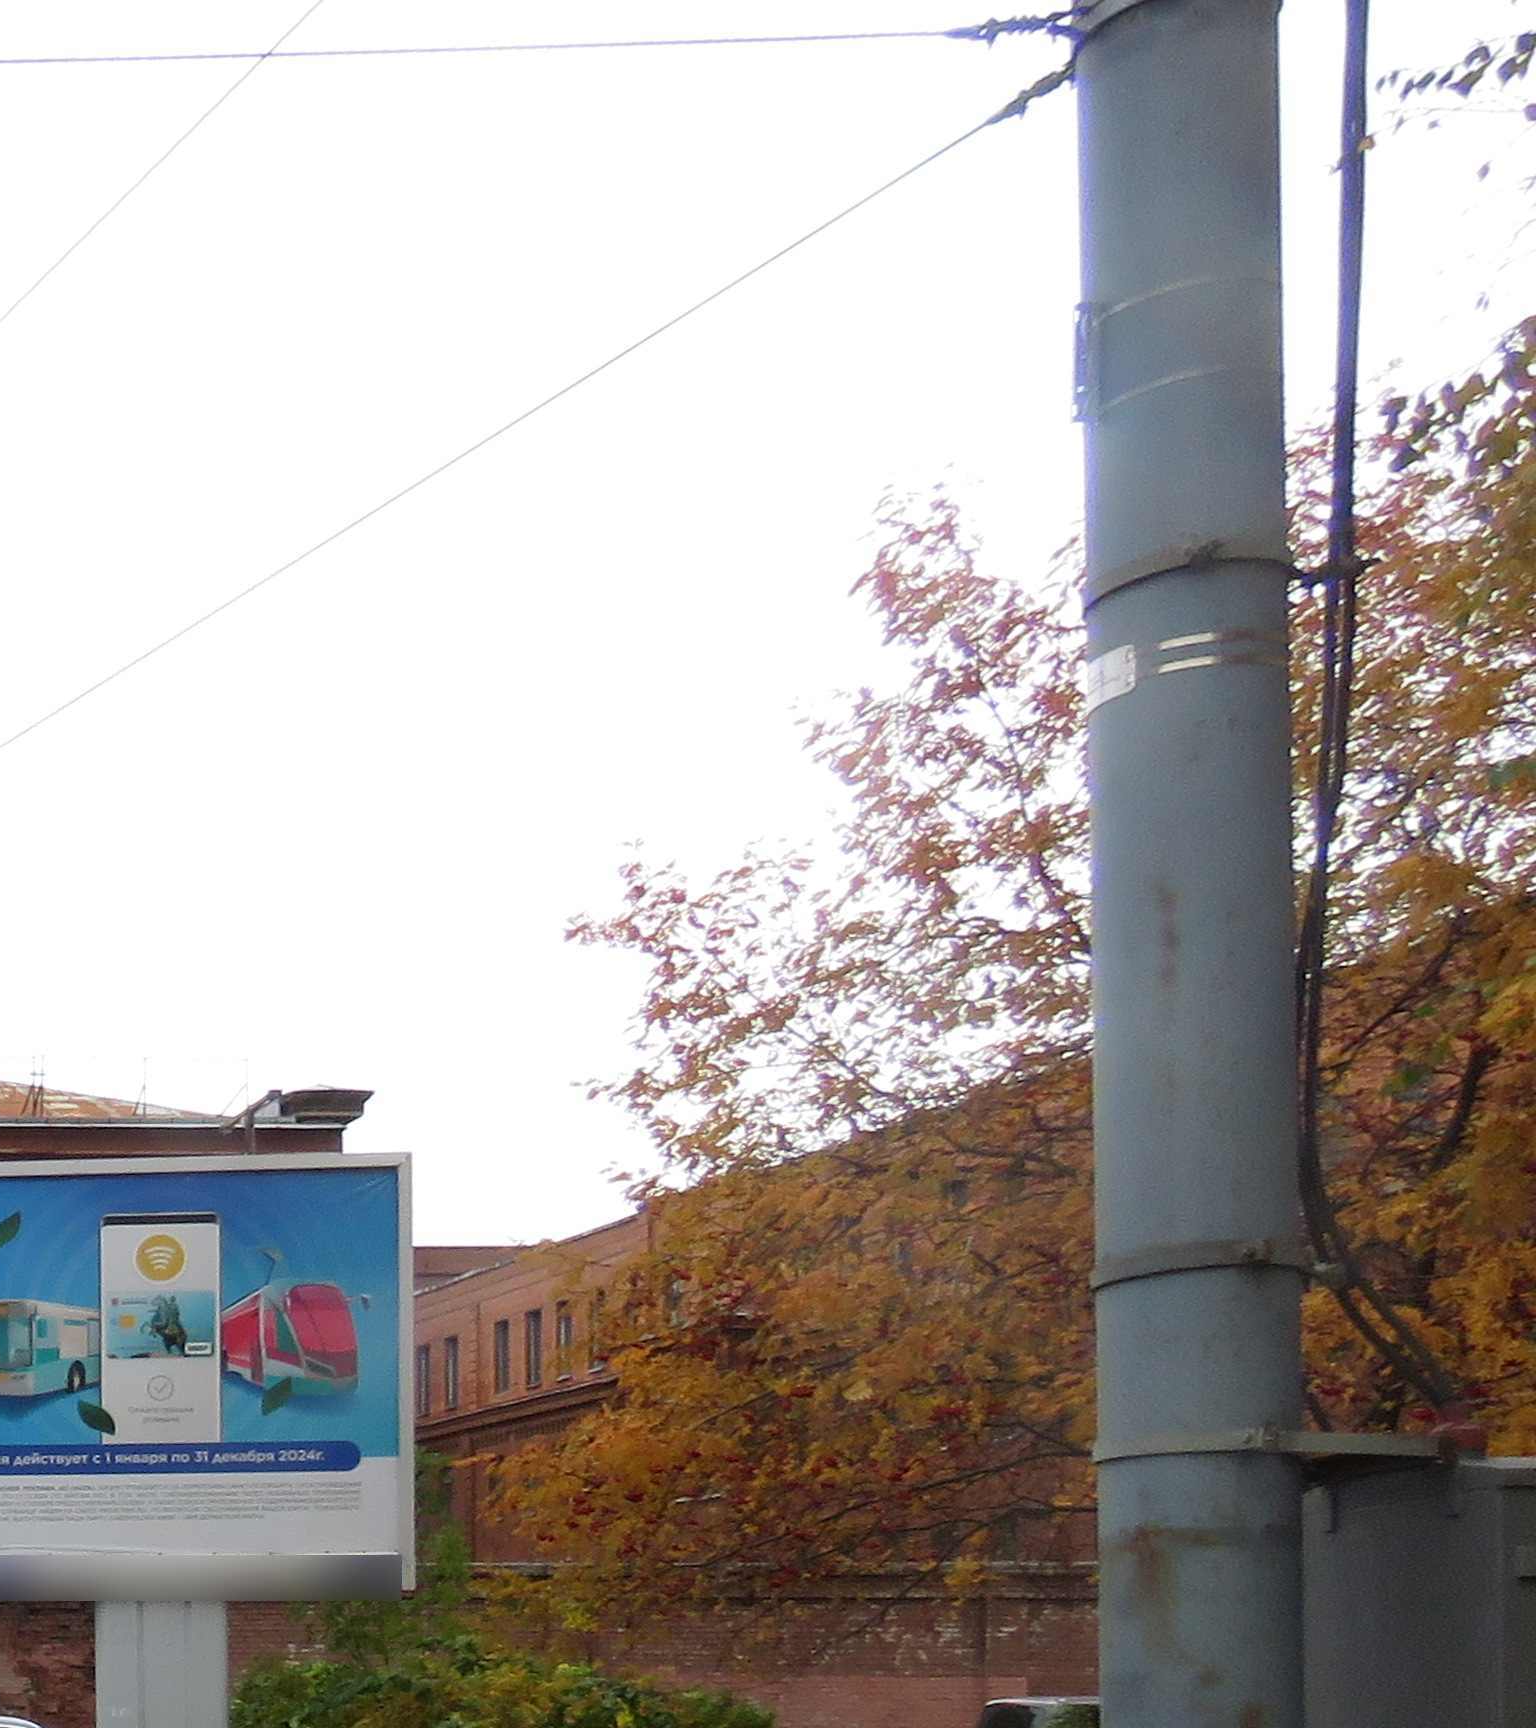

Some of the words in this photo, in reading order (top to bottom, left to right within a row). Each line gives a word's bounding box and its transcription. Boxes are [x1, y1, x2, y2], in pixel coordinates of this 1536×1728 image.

[13, 1452, 89, 1467] действует
[115, 1453, 168, 1464] января
[171, 1453, 190, 1463] по
[193, 1450, 208, 1463] 31
[211, 1449, 275, 1465] декабря
